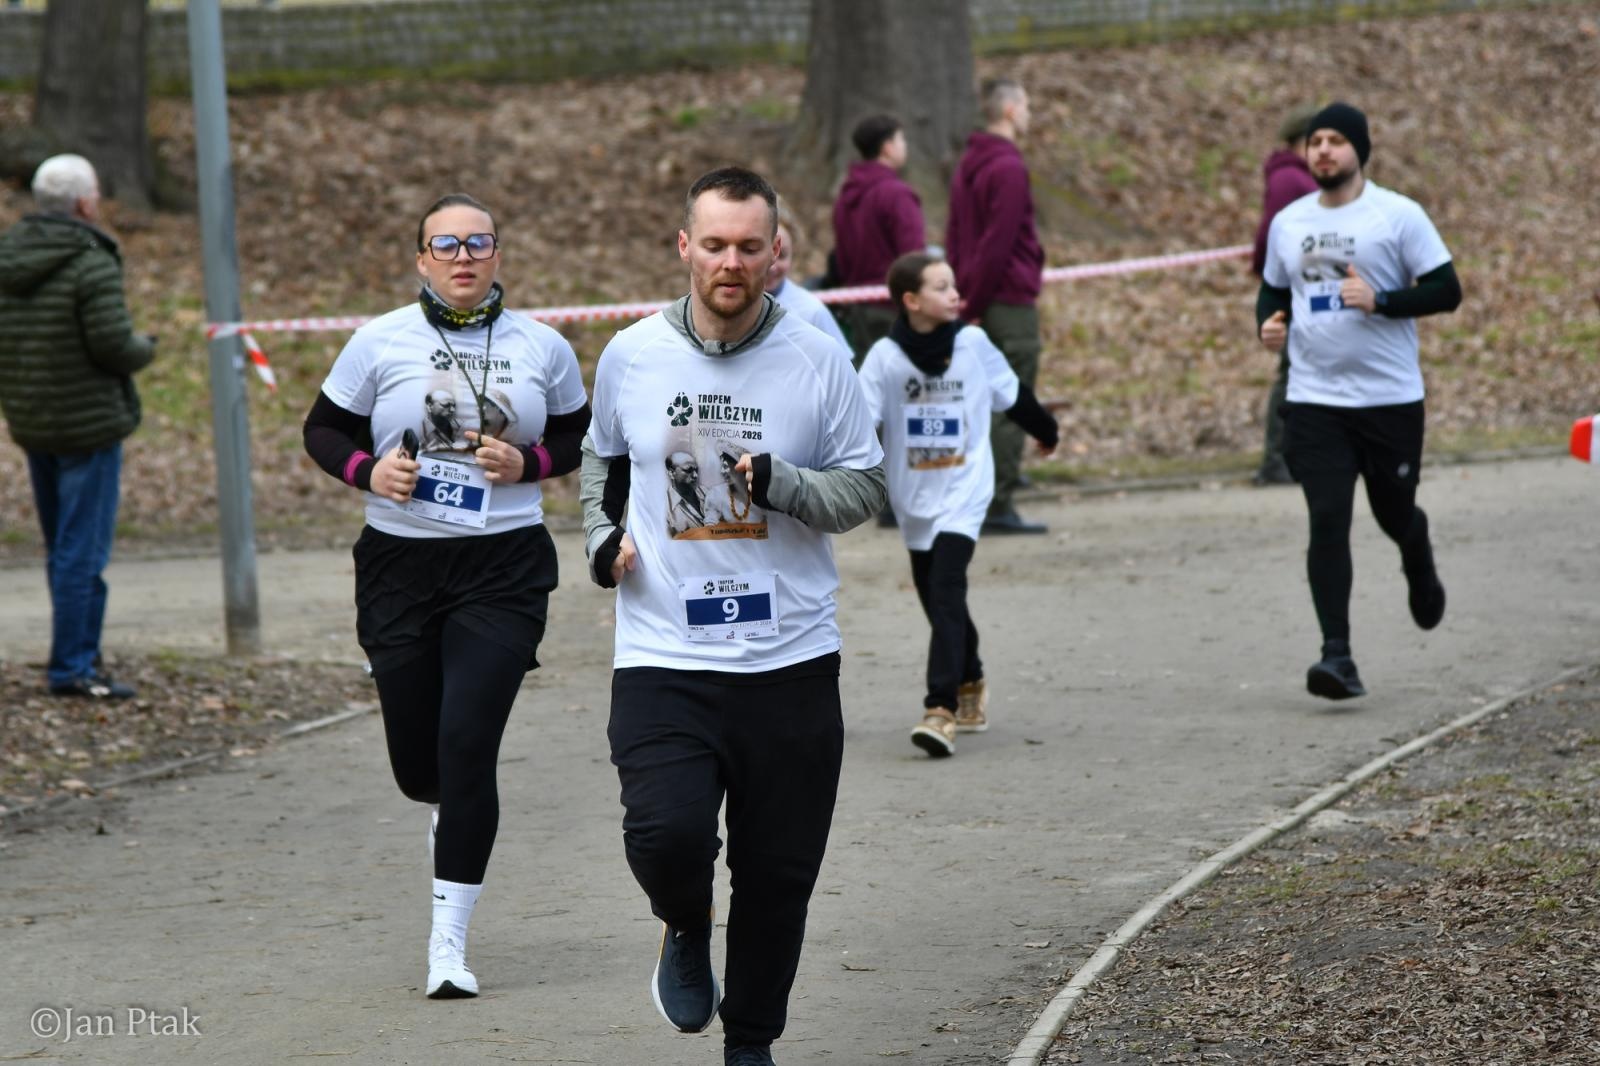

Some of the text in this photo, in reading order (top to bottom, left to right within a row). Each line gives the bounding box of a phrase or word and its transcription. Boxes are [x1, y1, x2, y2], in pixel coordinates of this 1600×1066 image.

[495, 376, 513, 384] 2026
[698, 394, 731, 404] TROPEM
[698, 405, 762, 423] WILCZYM
[922, 419, 945, 435] 89
[698, 428, 762, 440] XIV EDYCJA 2026
[443, 471, 470, 481] WILCZYM
[434, 482, 463, 506] 64
[718, 582, 750, 593] WILCZYM
[722, 598, 739, 622] 9
